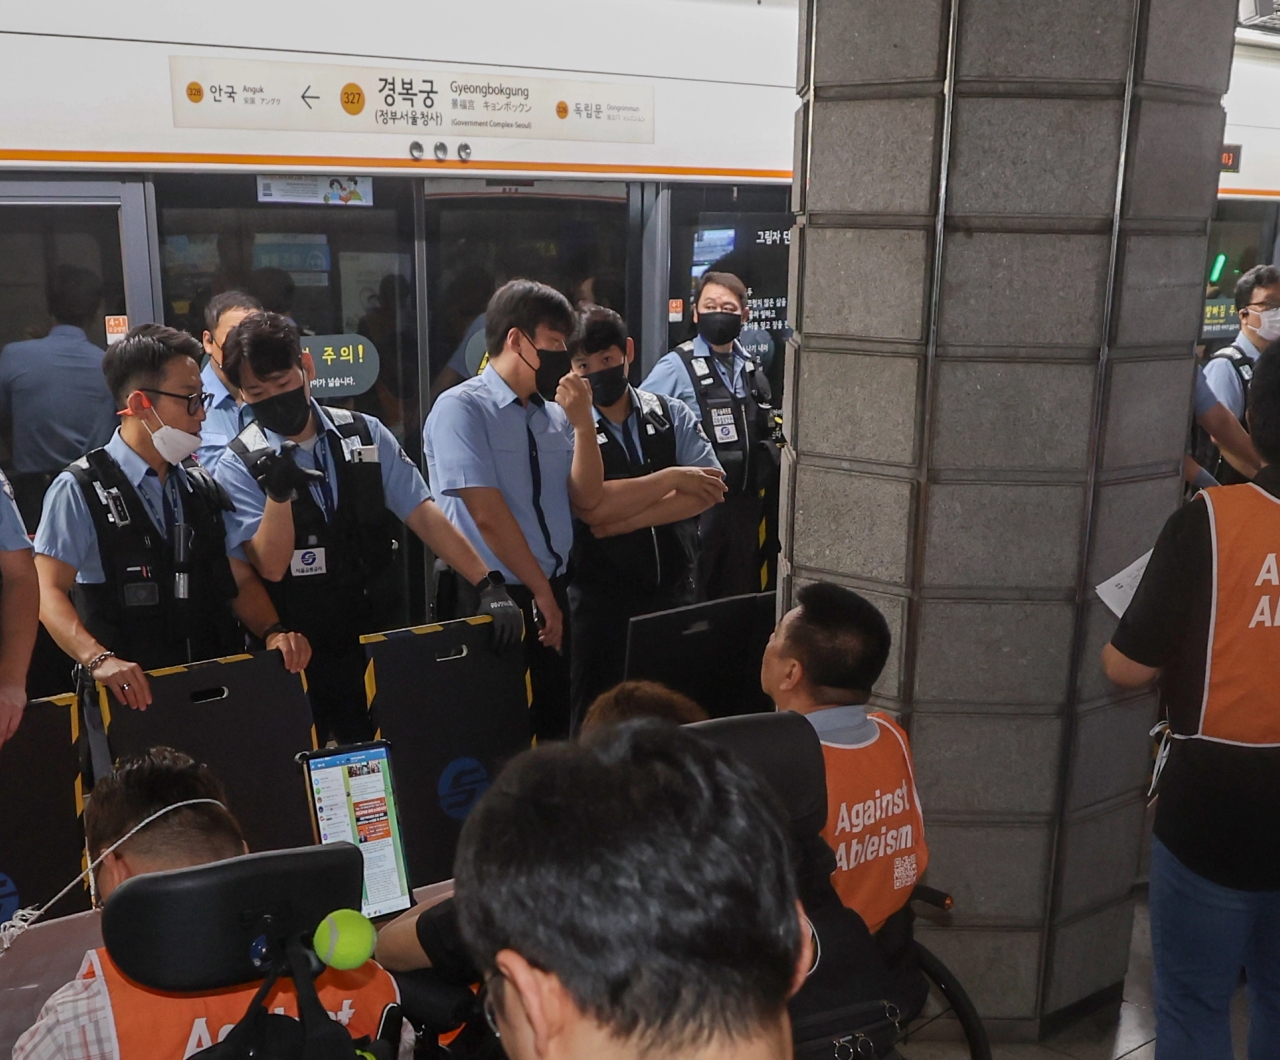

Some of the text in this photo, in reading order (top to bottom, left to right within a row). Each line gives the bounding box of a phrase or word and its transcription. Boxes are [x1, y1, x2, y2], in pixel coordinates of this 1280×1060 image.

[188, 87, 201, 96] 328
[210, 84, 237, 103] 안국
[242, 85, 264, 95] Anguk
[343, 92, 361, 104] 327
[377, 76, 438, 108] 경복궁
[450, 80, 530, 100] Gyeongbokgung
[375, 109, 443, 126] (정부서울청사)
[573, 102, 603, 119] 독립문
[451, 118, 532, 129] (Government Complex-Seoul)
[756, 230, 781, 245] 그림자
[322, 344, 365, 366] 주의!
[834, 779, 910, 836] Against
